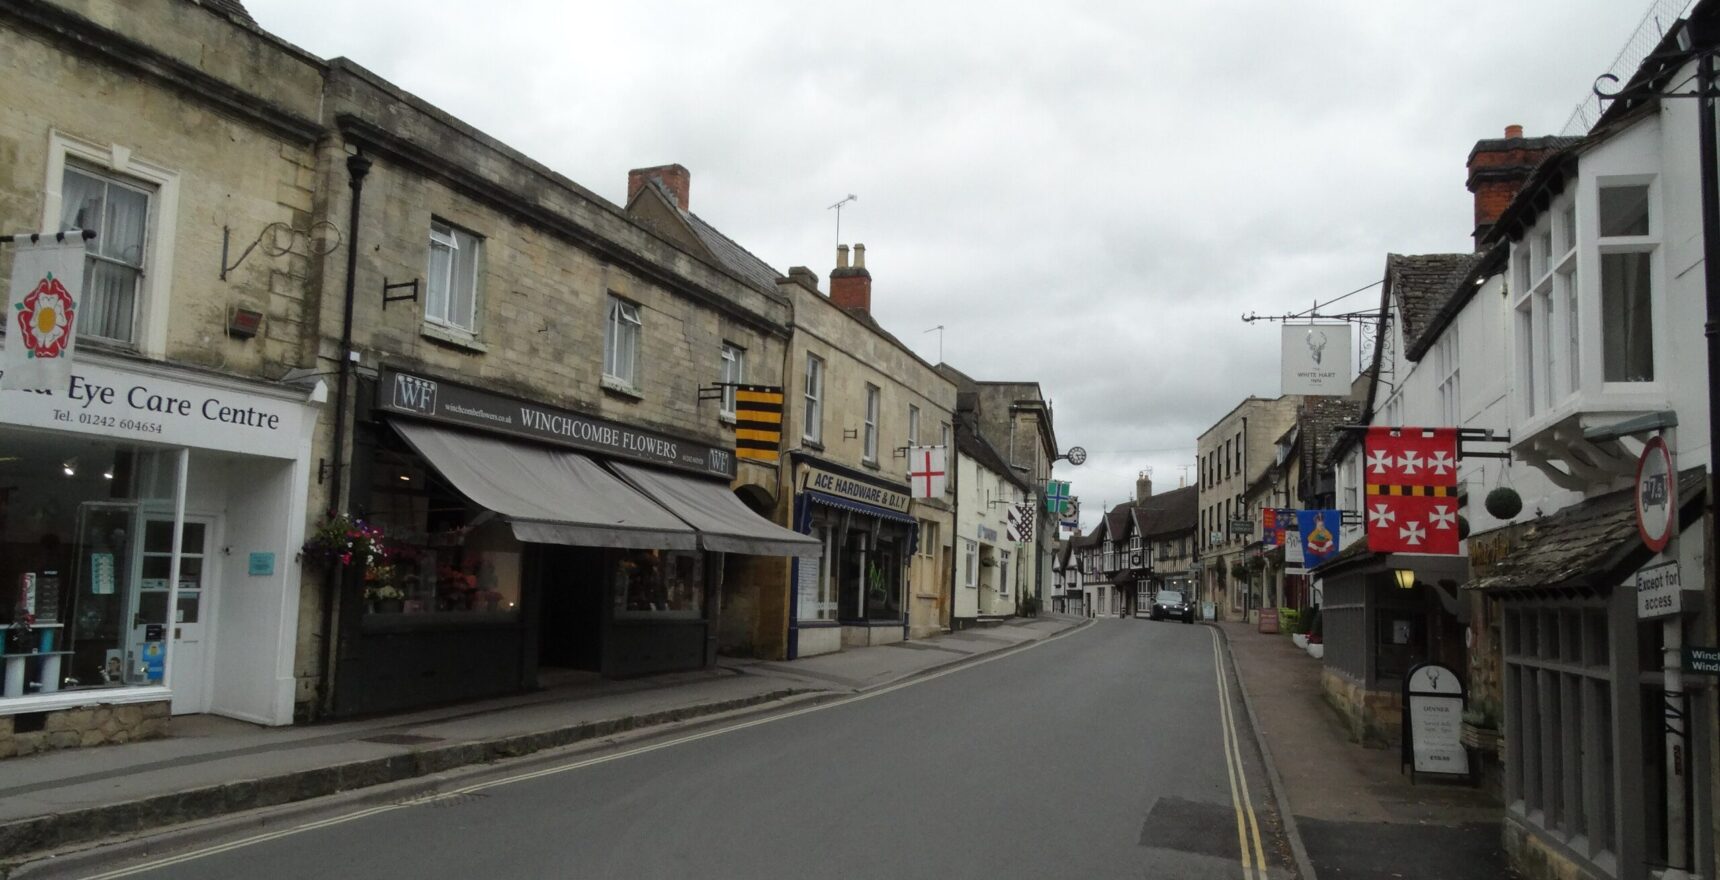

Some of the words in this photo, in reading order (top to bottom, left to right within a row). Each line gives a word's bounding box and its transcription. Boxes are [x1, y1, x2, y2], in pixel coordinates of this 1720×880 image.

[68, 375, 115, 409] Eye
[127, 386, 191, 416] Care
[201, 398, 279, 430] Centre
[399, 381, 433, 409] WF
[53, 409, 73, 422] Tel.
[79, 413, 115, 427] 01242
[119, 419, 163, 434] 604654
[520, 407, 620, 447] WINCHCOMBE
[623, 432, 677, 460] FLOWERS
[711, 451, 727, 472] WF
[814, 473, 834, 490] ACE
[835, 478, 881, 503] HARDWARE
[881, 491, 888, 504] &
[1637, 574, 1663, 592] Except
[1665, 570, 1678, 586] for
[1645, 595, 1672, 610] access
